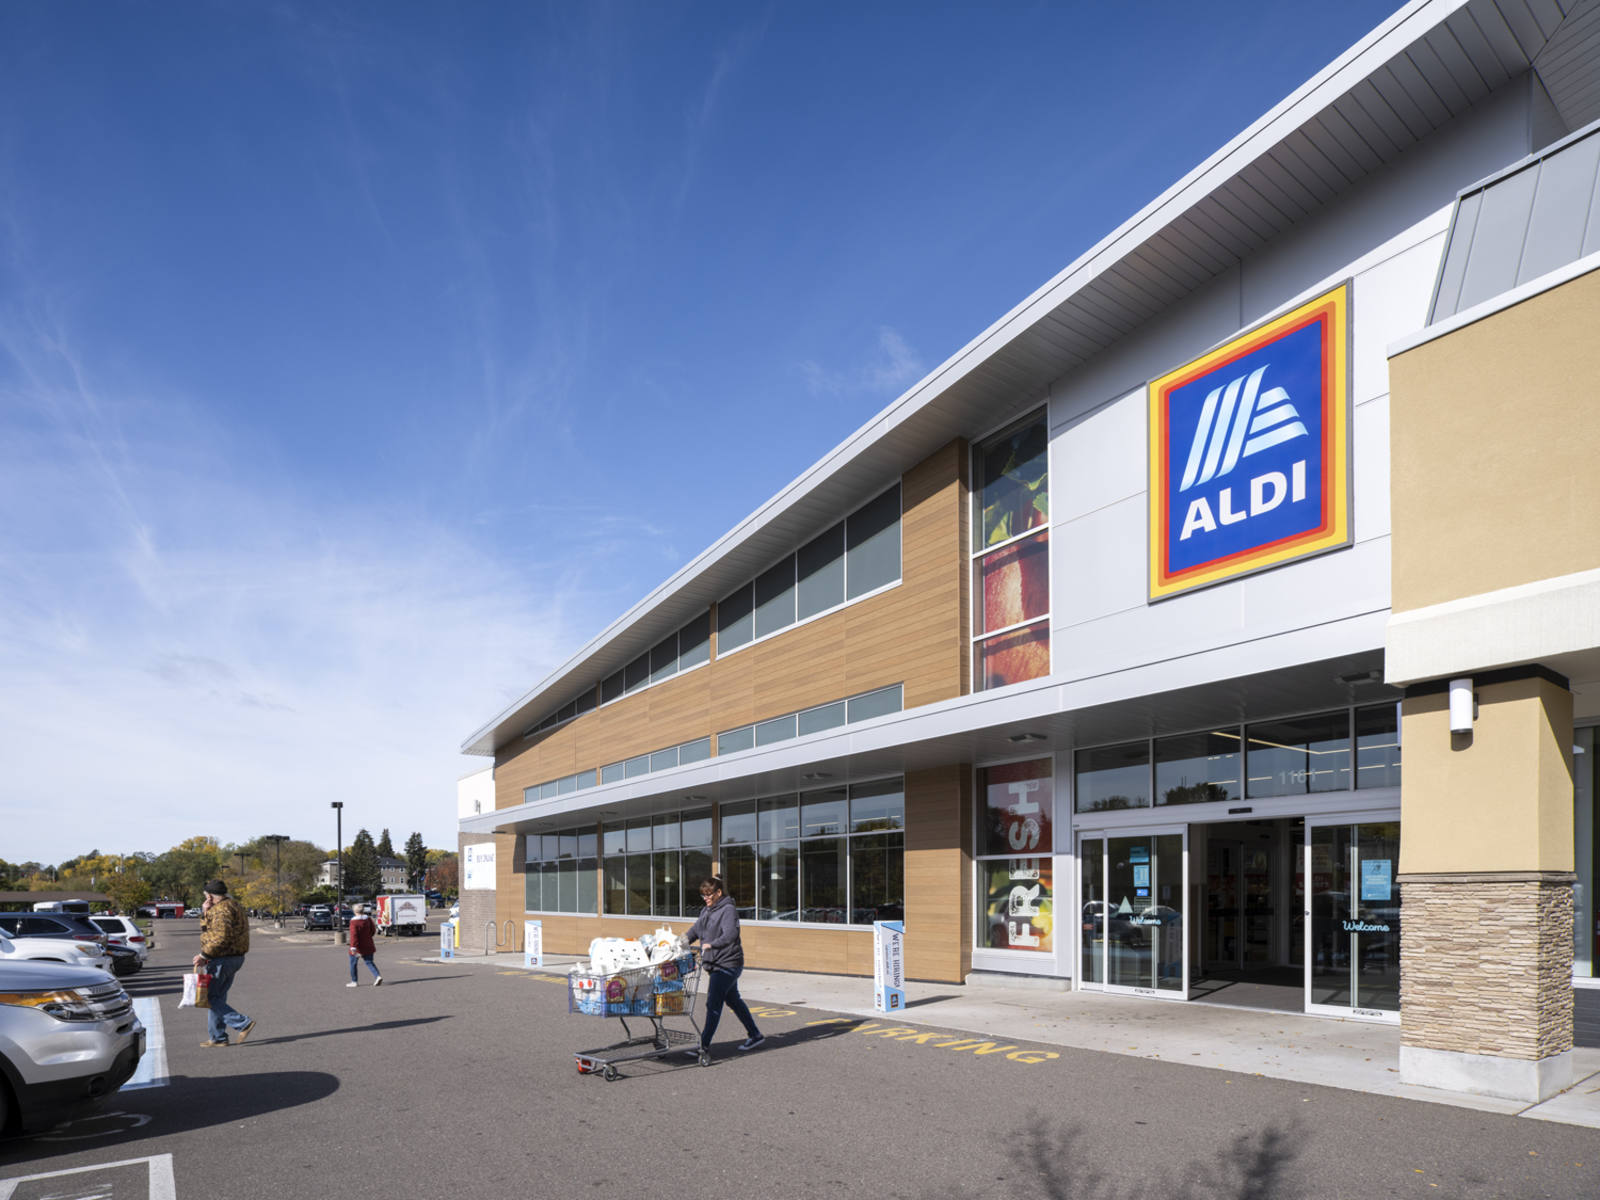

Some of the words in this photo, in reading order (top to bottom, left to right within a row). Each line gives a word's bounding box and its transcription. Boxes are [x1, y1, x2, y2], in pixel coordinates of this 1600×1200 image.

[1179, 459, 1307, 541] ALDI
[1008, 779, 1040, 947] FRESH
[1342, 919, 1390, 932] Welcome
[805, 1017, 1060, 1064] PARKING
